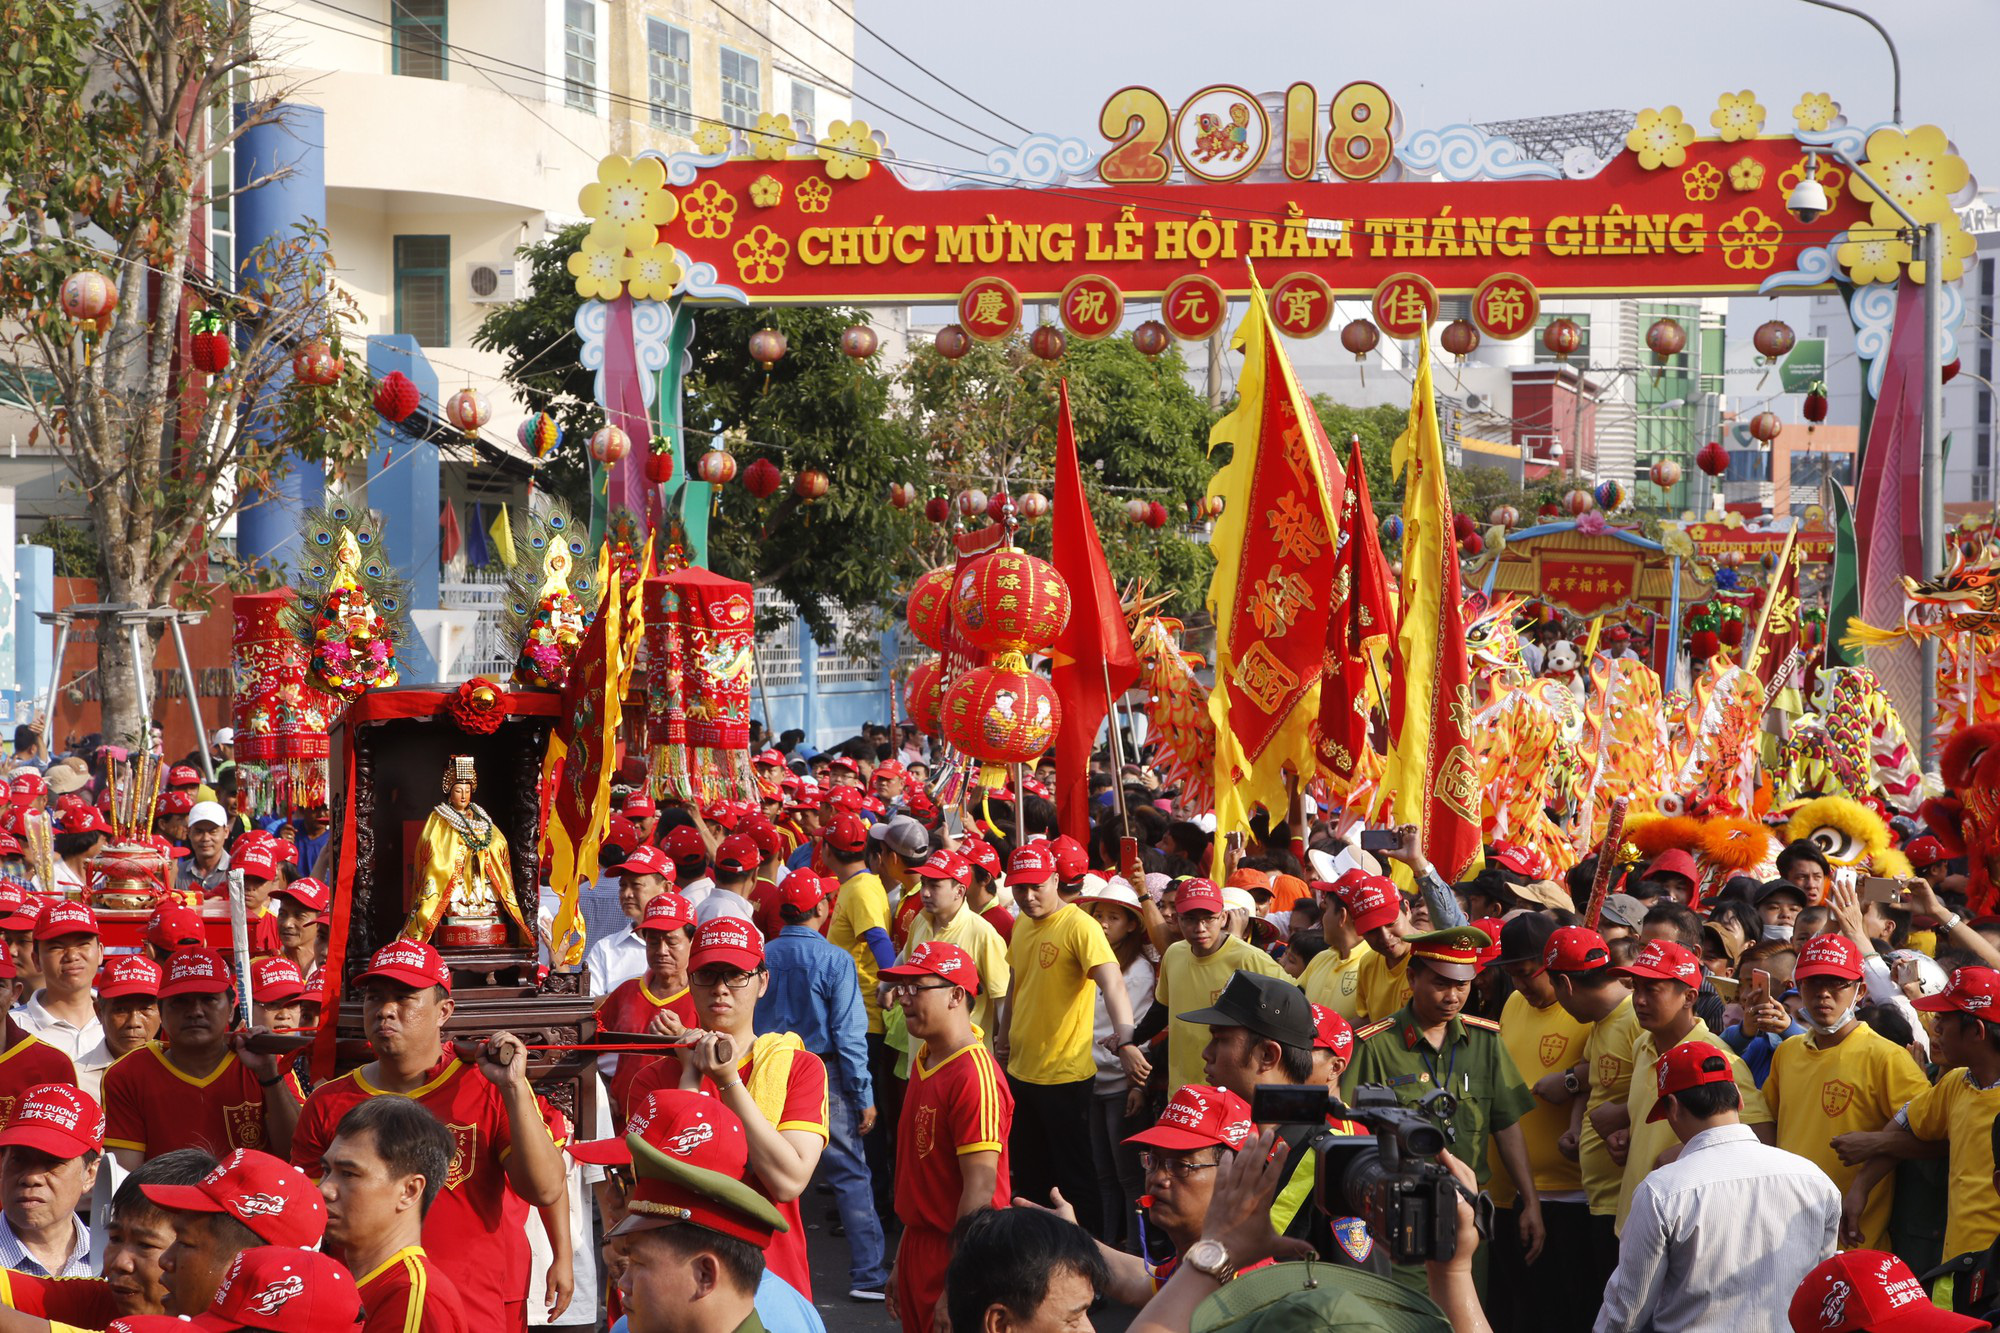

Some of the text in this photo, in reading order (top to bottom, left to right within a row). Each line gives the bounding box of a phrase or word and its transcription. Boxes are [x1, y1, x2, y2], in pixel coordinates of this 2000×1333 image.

[1098, 80, 1396, 184] 2018
[797, 214, 926, 266] CHÚC
[935, 213, 1075, 263] MỪNG
[1086, 203, 1144, 262] LỄ
[1155, 210, 1238, 268] HỘI
[1364, 205, 1534, 257] THÁNG
[1545, 204, 1708, 256] GIÊNG
[22, 1101, 80, 1122] BÌNH DƯƠNG
[1172, 1103, 1204, 1121] DƯƠNG
[678, 1130, 714, 1147] STING
[244, 1200, 284, 1214] STING
[1874, 1259, 1893, 1286] LỄ HỘI
[262, 1282, 305, 1306] STING
[1884, 1280, 1910, 1296] BÌNH
[1890, 1287, 1928, 1310] 土龍木天
[1826, 1285, 1851, 1320] STING
